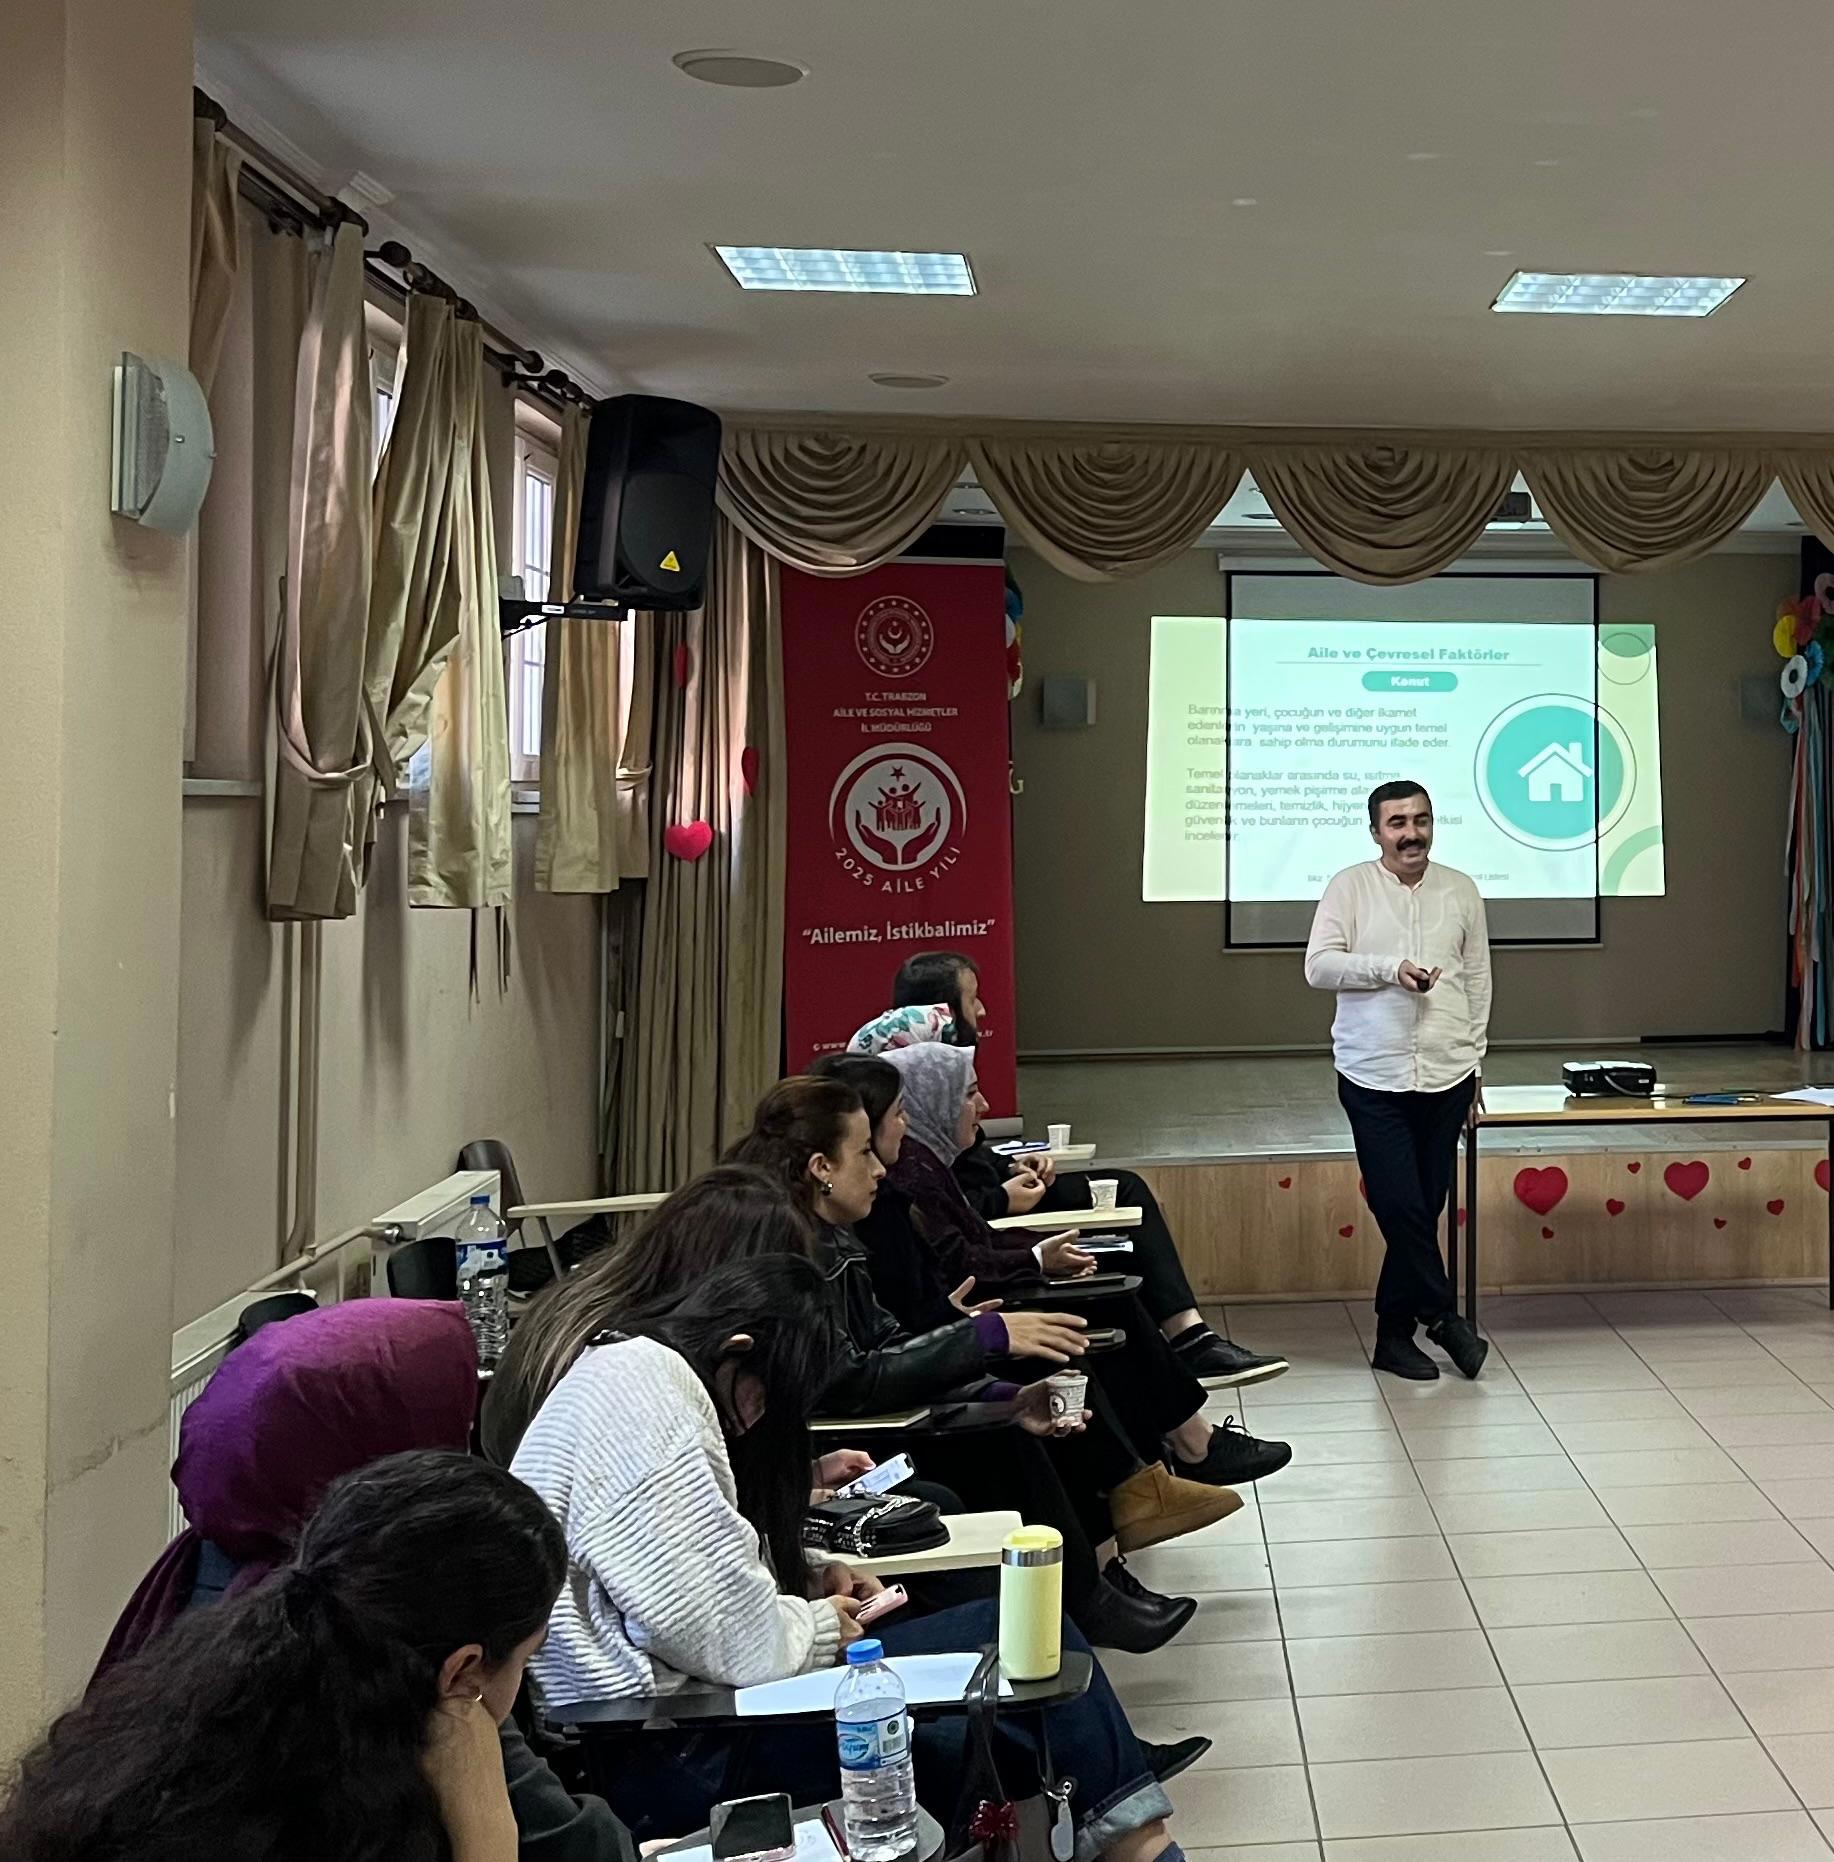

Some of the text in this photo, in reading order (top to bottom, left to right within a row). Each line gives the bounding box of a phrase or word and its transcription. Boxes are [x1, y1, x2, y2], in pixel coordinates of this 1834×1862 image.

[1307, 647, 1510, 661] Aile ve Çevresel Faktörler
[1391, 676, 1431, 688] Konut
[869, 707, 905, 717] SOSYAL
[1244, 708, 1271, 720] yeri,
[1274, 706, 1325, 720] çocuğun
[1327, 710, 1342, 718] ve
[1345, 707, 1376, 720] diğer
[1378, 707, 1417, 718] ikamet
[1187, 719, 1246, 731] edenlin
[1295, 724, 1311, 732] ve
[1313, 721, 1373, 736] gelişimine
[1375, 723, 1412, 735] uygun
[1415, 722, 1448, 733] temel
[1186, 735, 1252, 747] olanaara
[1259, 736, 1292, 749] sahip
[1294, 737, 1324, 747] olma
[1327, 737, 1387, 748] durumunu
[1186, 768, 1224, 779] Temel
[1228, 770, 1284, 781] lanaklar
[1287, 769, 1340, 781] arasında
[1342, 772, 1361, 783] su,
[1185, 783, 1258, 797] sanitayon,
[1260, 785, 1301, 798] yemek
[1304, 786, 1348, 798] pişirme
[1185, 799, 1277, 812] düzenmeleri,
[1279, 801, 1328, 812] temizlik,
[1184, 814, 1463, 829] güvenk ve bunların çocuğun tkisi
[835, 847, 875, 886] 2025
[929, 847, 961, 879] YILI
[802, 919, 996, 945] “Ailemiz, İstikbalimiz”
